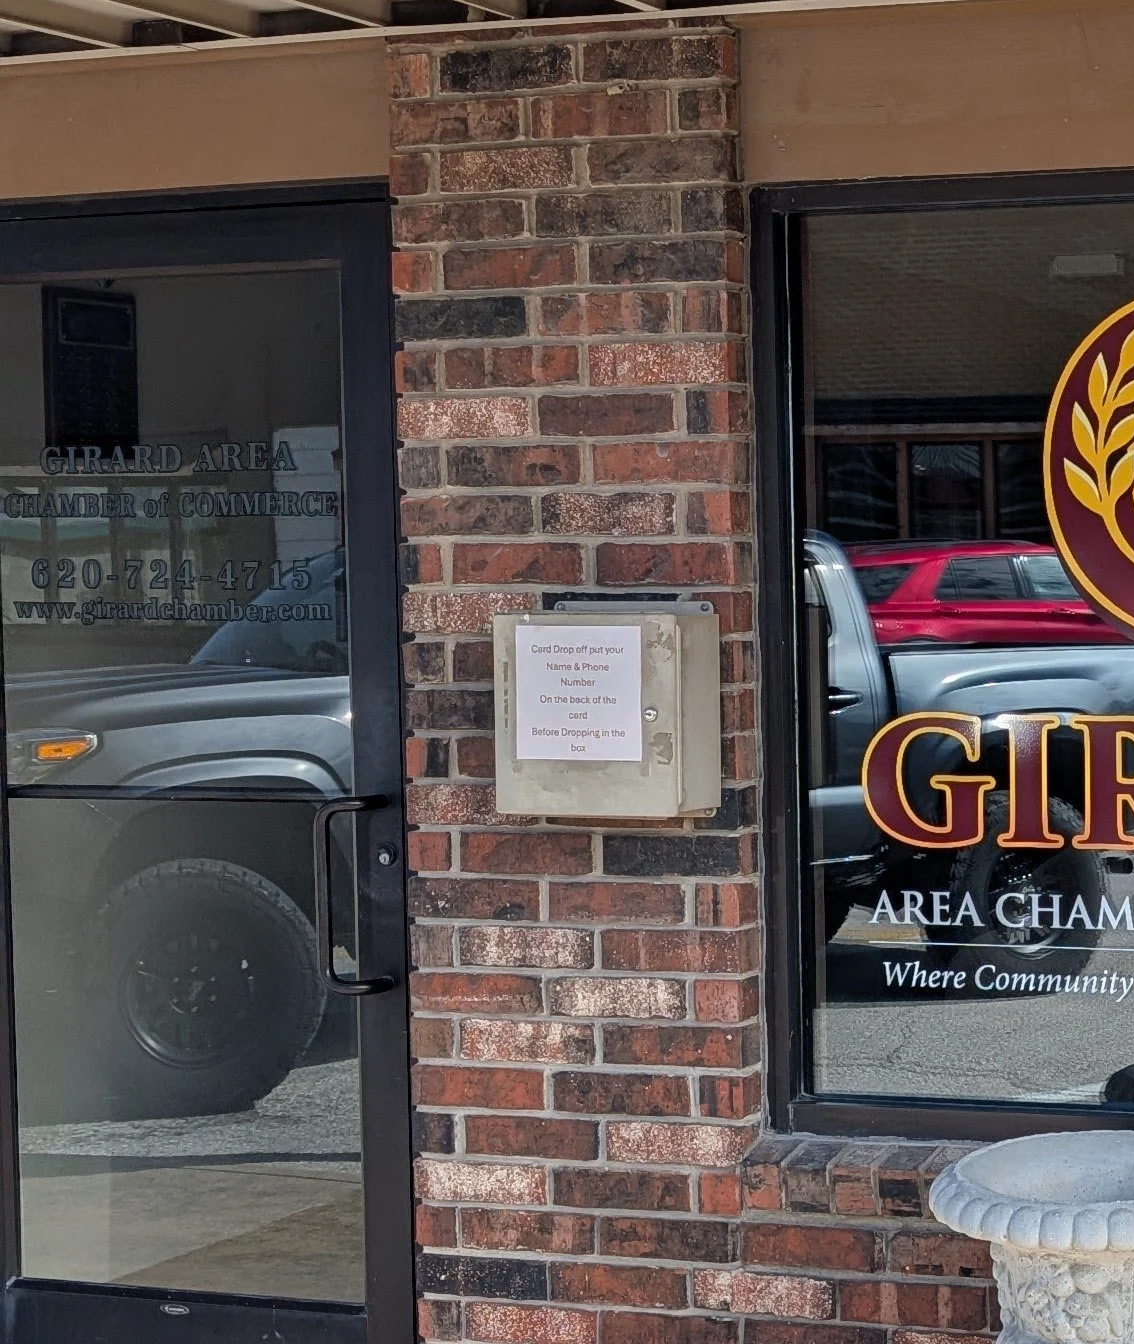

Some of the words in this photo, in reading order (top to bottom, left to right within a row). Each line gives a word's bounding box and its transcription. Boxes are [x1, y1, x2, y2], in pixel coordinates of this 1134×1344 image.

[40, 443, 183, 474] GIRARD
[192, 441, 297, 472] AREA
[2, 492, 136, 518] CHAMBER
[143, 492, 170, 518] of
[178, 491, 338, 517] COMMERCE
[30, 558, 312, 590] 620-724-4715
[13, 597, 332, 625] www.girardchamber.com
[531, 644, 552, 654] Card
[553, 644, 575, 655] Drop
[576, 644, 588, 654] off
[589, 646, 603, 655] put
[605, 647, 624, 655] your
[546, 662, 572, 671] Name
[574, 662, 580, 671] &
[582, 662, 609, 671] Phone
[560, 678, 595, 687] Number
[540, 695, 552, 704] On
[553, 695, 568, 704] the
[570, 695, 591, 704] back
[592, 696, 602, 704] of
[602, 696, 617, 704] the
[568, 711, 588, 720] card
[532, 727, 559, 736] Before
[561, 727, 600, 738] Dropping
[601, 728, 610, 737] in
[611, 728, 625, 737] the
[571, 743, 586, 752] box
[868, 889, 986, 927] AREA
[883, 960, 966, 990] Where
[974, 964, 1134, 1003] Community
